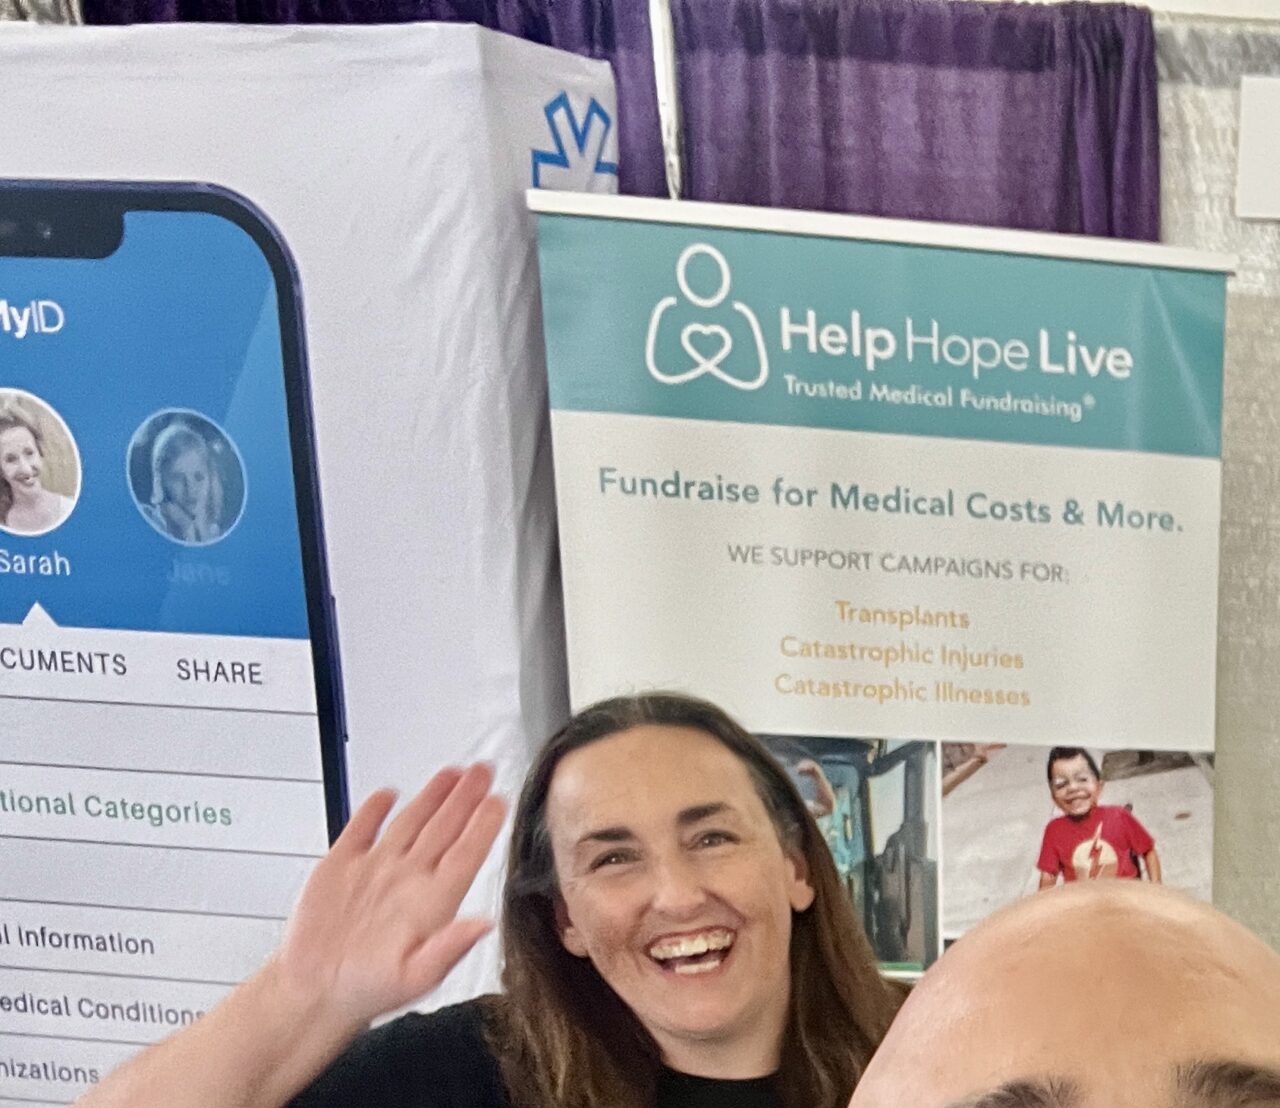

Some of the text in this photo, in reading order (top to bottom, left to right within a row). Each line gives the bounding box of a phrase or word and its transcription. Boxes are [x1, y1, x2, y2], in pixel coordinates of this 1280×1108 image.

[781, 306, 1134, 380] Help Hope Live
[784, 374, 862, 401] Trusted
[869, 383, 953, 408] Medical
[599, 466, 1184, 533] Fundraise for Medical Costs & More.
[727, 543, 764, 564] WE
[770, 547, 873, 571] SUPPORT
[880, 553, 1014, 580] CAMPAIGNS
[835, 599, 970, 631] Transplants
[780, 634, 1025, 672] Catastrophic Injuries
[176, 658, 263, 685] SHARE
[774, 672, 1032, 707] Catastrophic Illnesses
[84, 794, 232, 827] Categories
[18, 924, 156, 955] Information
